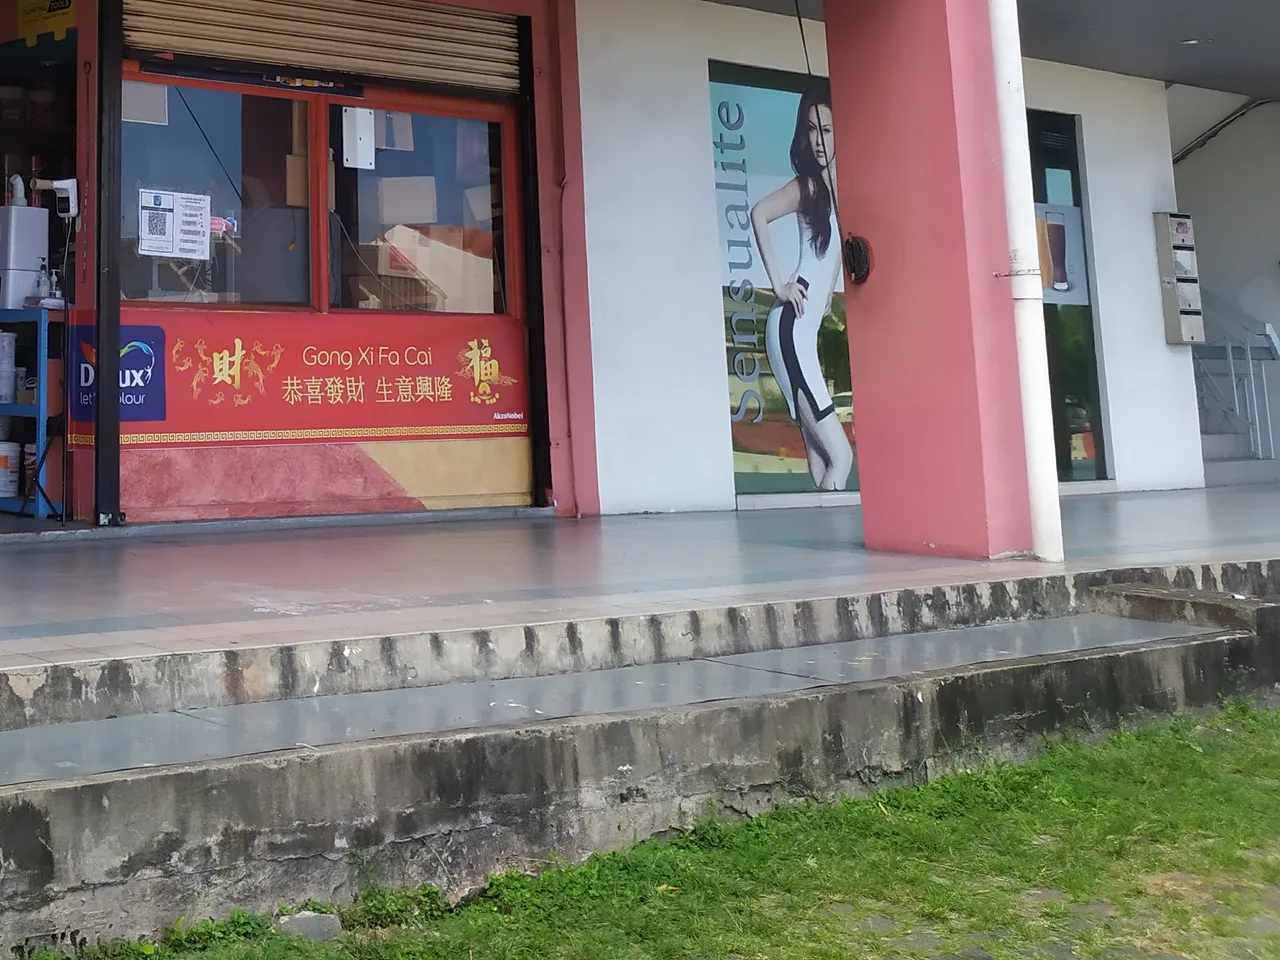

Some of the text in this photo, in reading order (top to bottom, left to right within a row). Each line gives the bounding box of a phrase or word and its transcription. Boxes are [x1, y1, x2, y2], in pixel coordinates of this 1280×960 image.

[712, 99, 763, 424] Sensualite
[212, 338, 246, 390] 財
[302, 346, 433, 370] Gong Xi Fa Cai
[467, 338, 499, 385] 福
[80, 363, 145, 388] Dux
[282, 375, 453, 405] 恭喜發財 生意興隆
[493, 412, 524, 420] AkzoNobel
